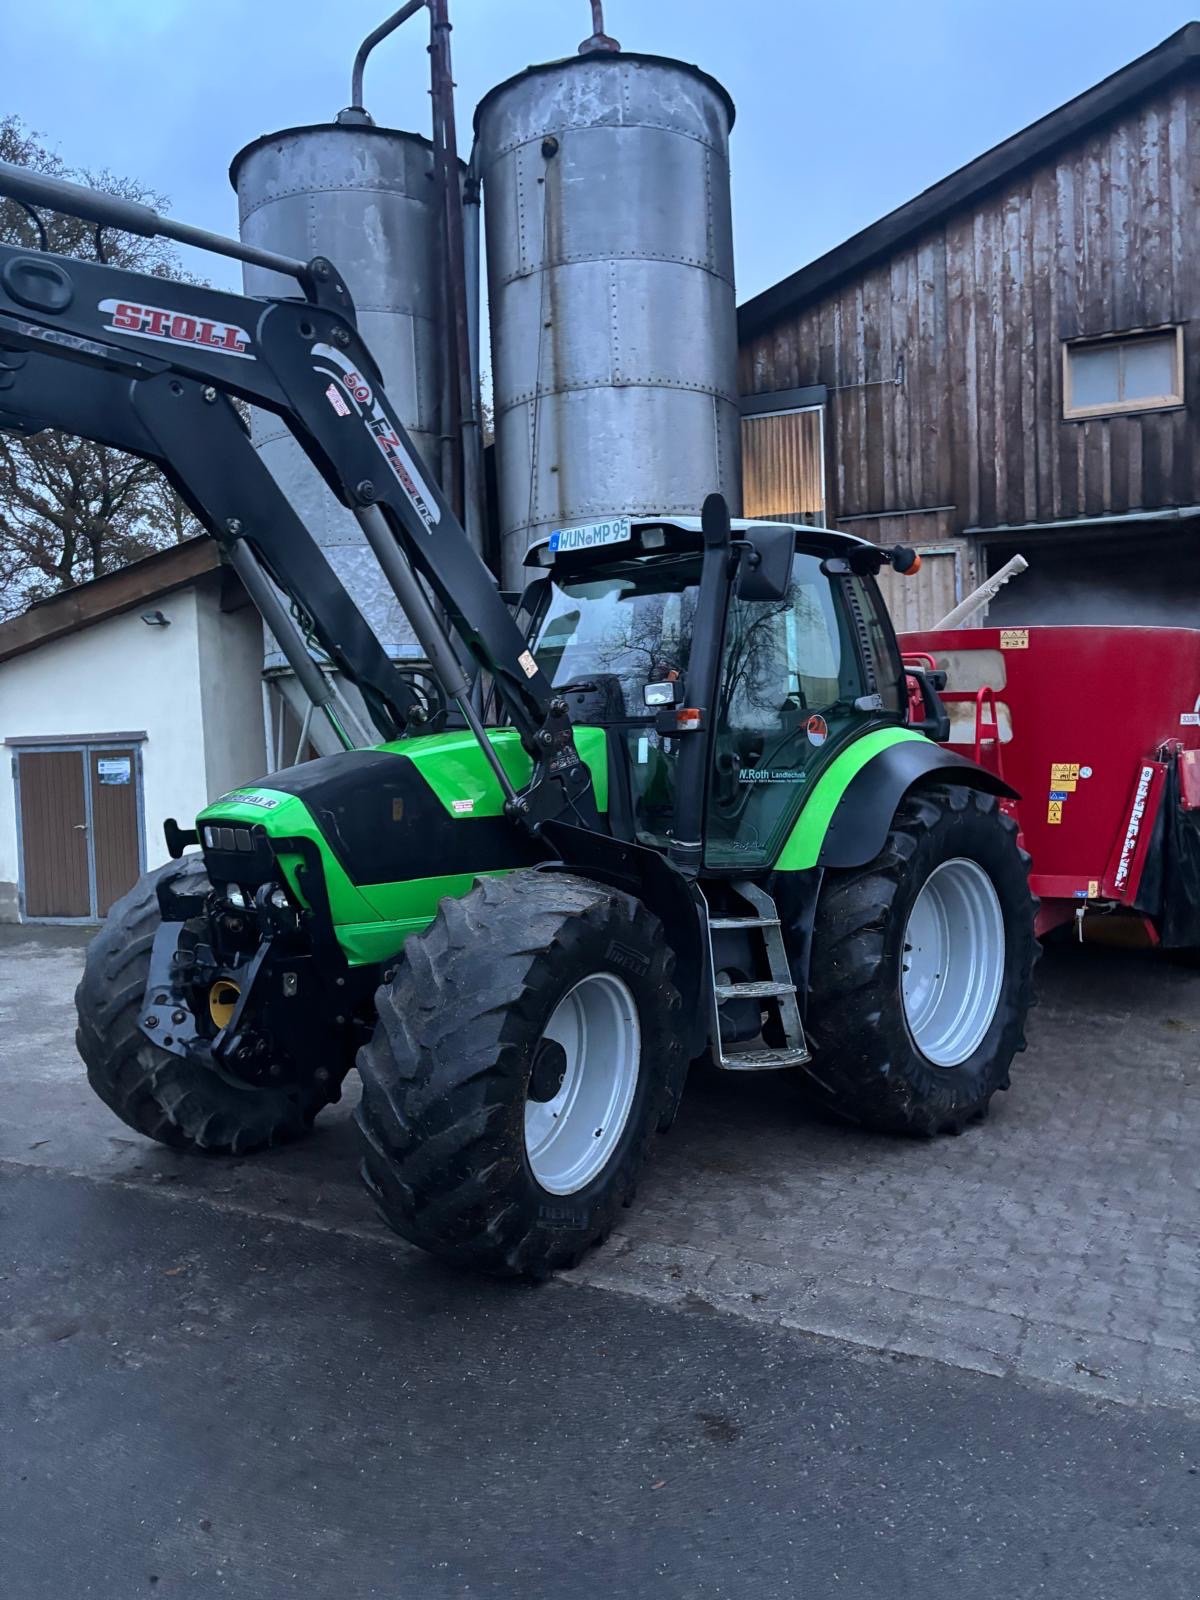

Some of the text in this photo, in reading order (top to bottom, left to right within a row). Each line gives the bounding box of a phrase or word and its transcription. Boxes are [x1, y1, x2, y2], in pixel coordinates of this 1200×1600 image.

[112, 303, 246, 352] STOLL
[343, 372, 370, 403] 50
[369, 418, 400, 453] FZ
[560, 528, 586, 549] WUN
[593, 524, 610, 543] MP
[613, 519, 628, 541] 95
